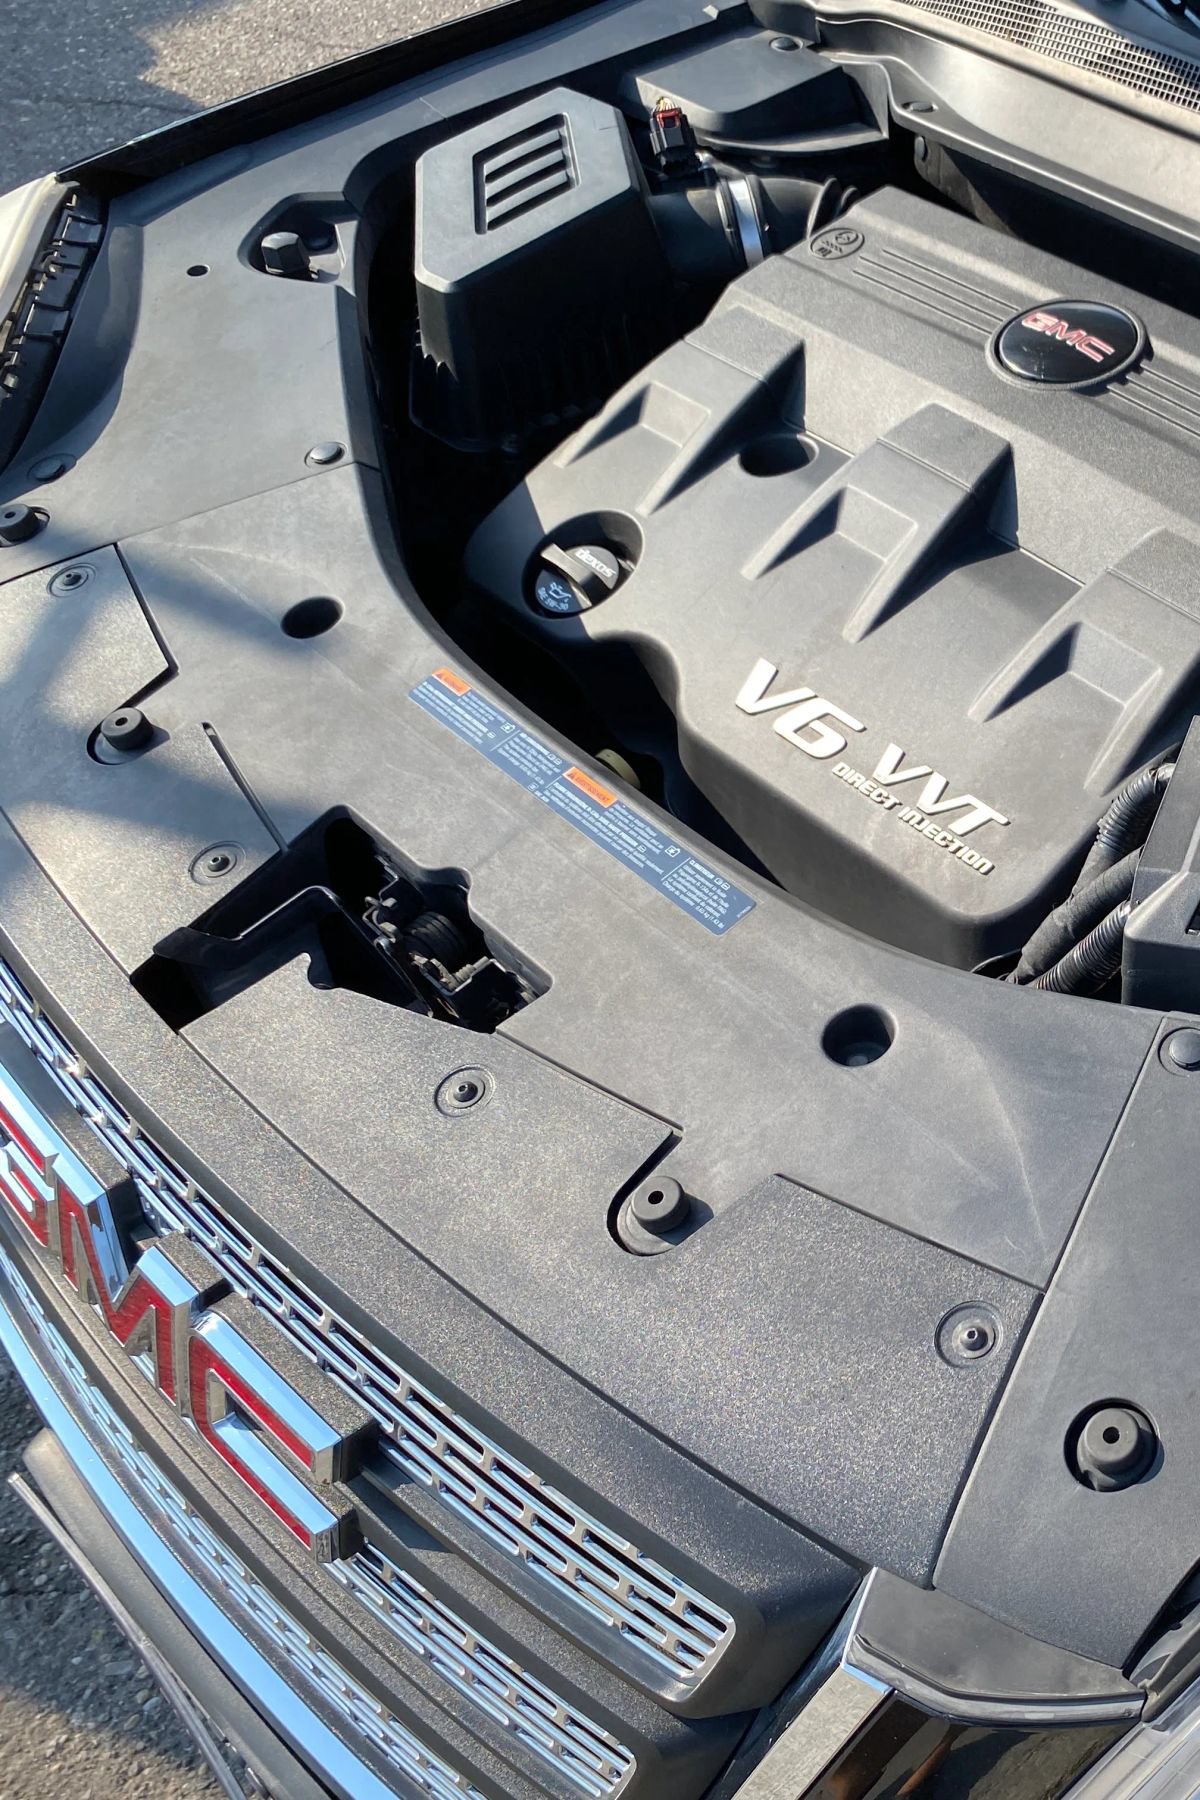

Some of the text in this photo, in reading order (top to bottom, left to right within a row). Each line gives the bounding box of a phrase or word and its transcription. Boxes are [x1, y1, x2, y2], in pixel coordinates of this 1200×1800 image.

[1021, 311, 1116, 363] GMC
[575, 548, 617, 578] dexos
[735, 657, 1011, 837] V6 VVT
[831, 761, 995, 876] DIRECT INJECTION
